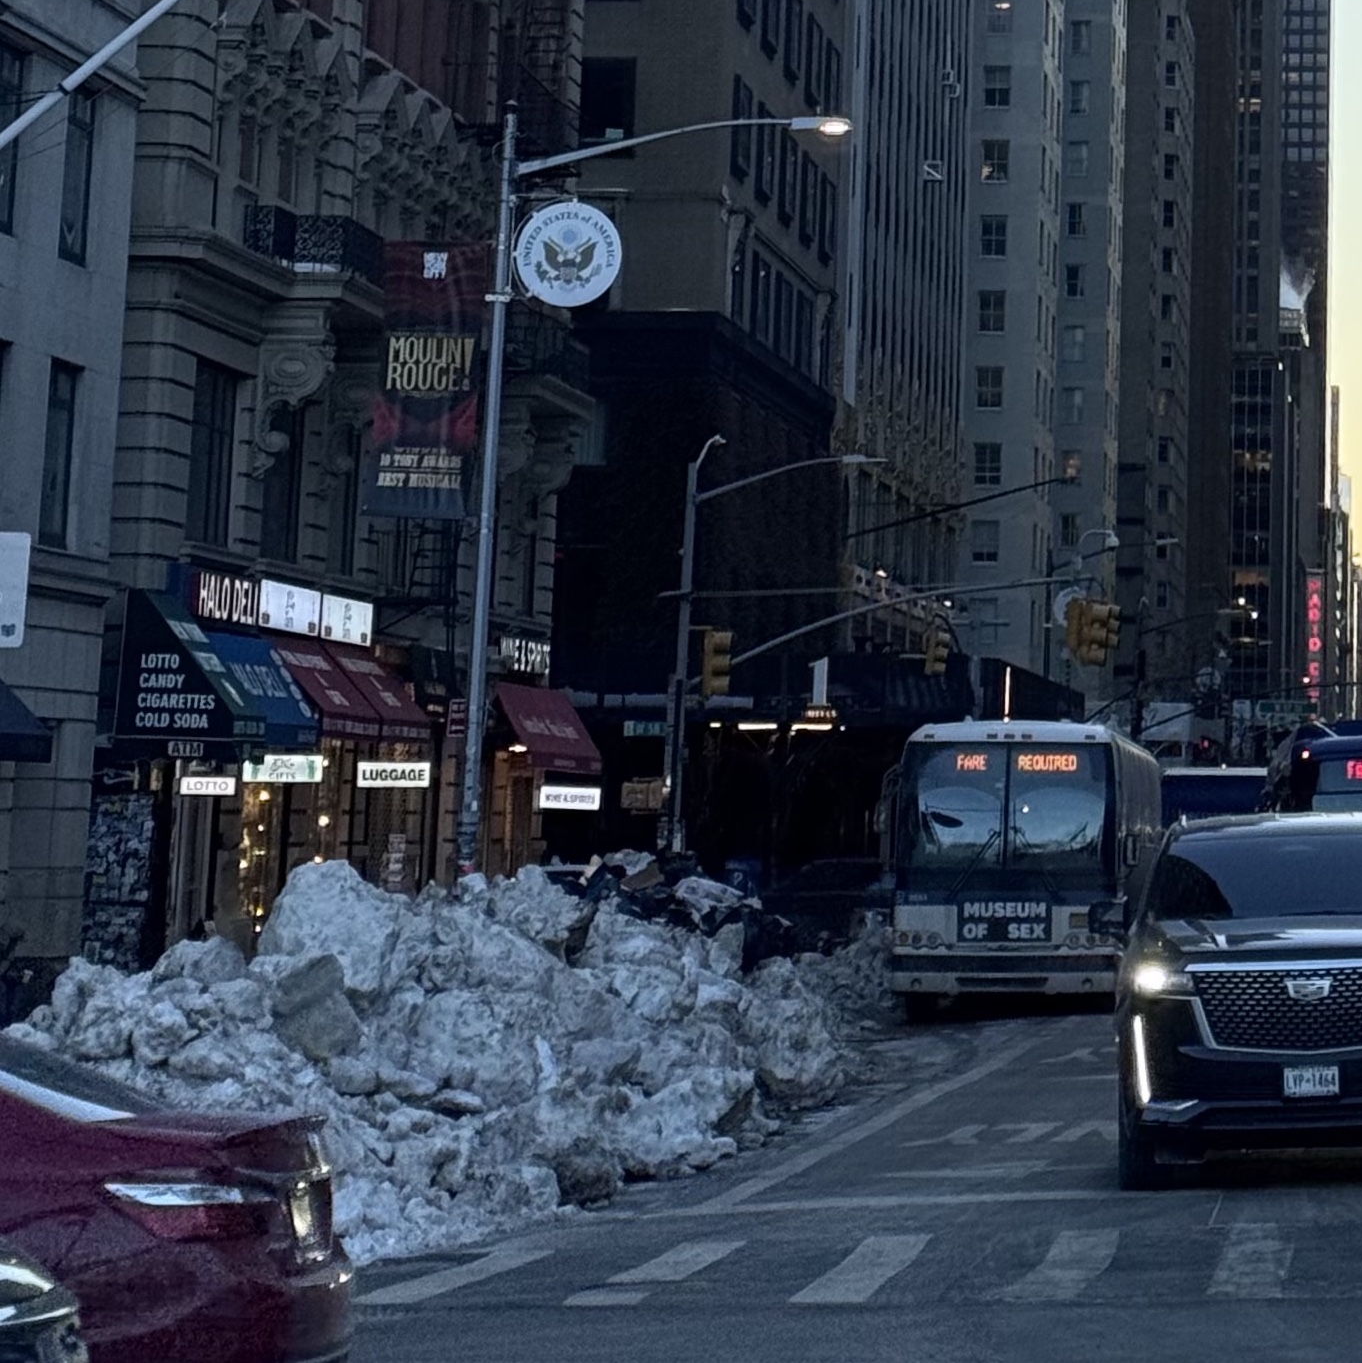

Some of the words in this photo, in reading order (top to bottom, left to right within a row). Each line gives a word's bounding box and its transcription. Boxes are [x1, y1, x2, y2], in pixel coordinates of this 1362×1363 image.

[523, 225, 542, 267] UNITED
[542, 211, 580, 227] STATES
[581, 216, 592, 224] of
[592, 221, 616, 268] AMERICA
[388, 336, 462, 364] MOULIN
[198, 571, 231, 621] HALO
[232, 578, 260, 626] DELI
[140, 653, 180, 669] LOTTO
[139, 673, 185, 688] CANDY
[137, 693, 215, 710] CIGARETTES
[135, 712, 169, 728] COLD
[173, 712, 208, 729] SODA
[172, 741, 201, 756] ATM
[956, 753, 988, 771] FARE
[1017, 754, 1078, 771] REQUIRED
[268, 772, 296, 780] GIFTS
[361, 769, 426, 782] LUGGAGE
[187, 781, 228, 791] LOTTO
[963, 902, 1047, 918] MUSEUM
[963, 923, 989, 939] OF
[1007, 923, 1047, 939] SEX
